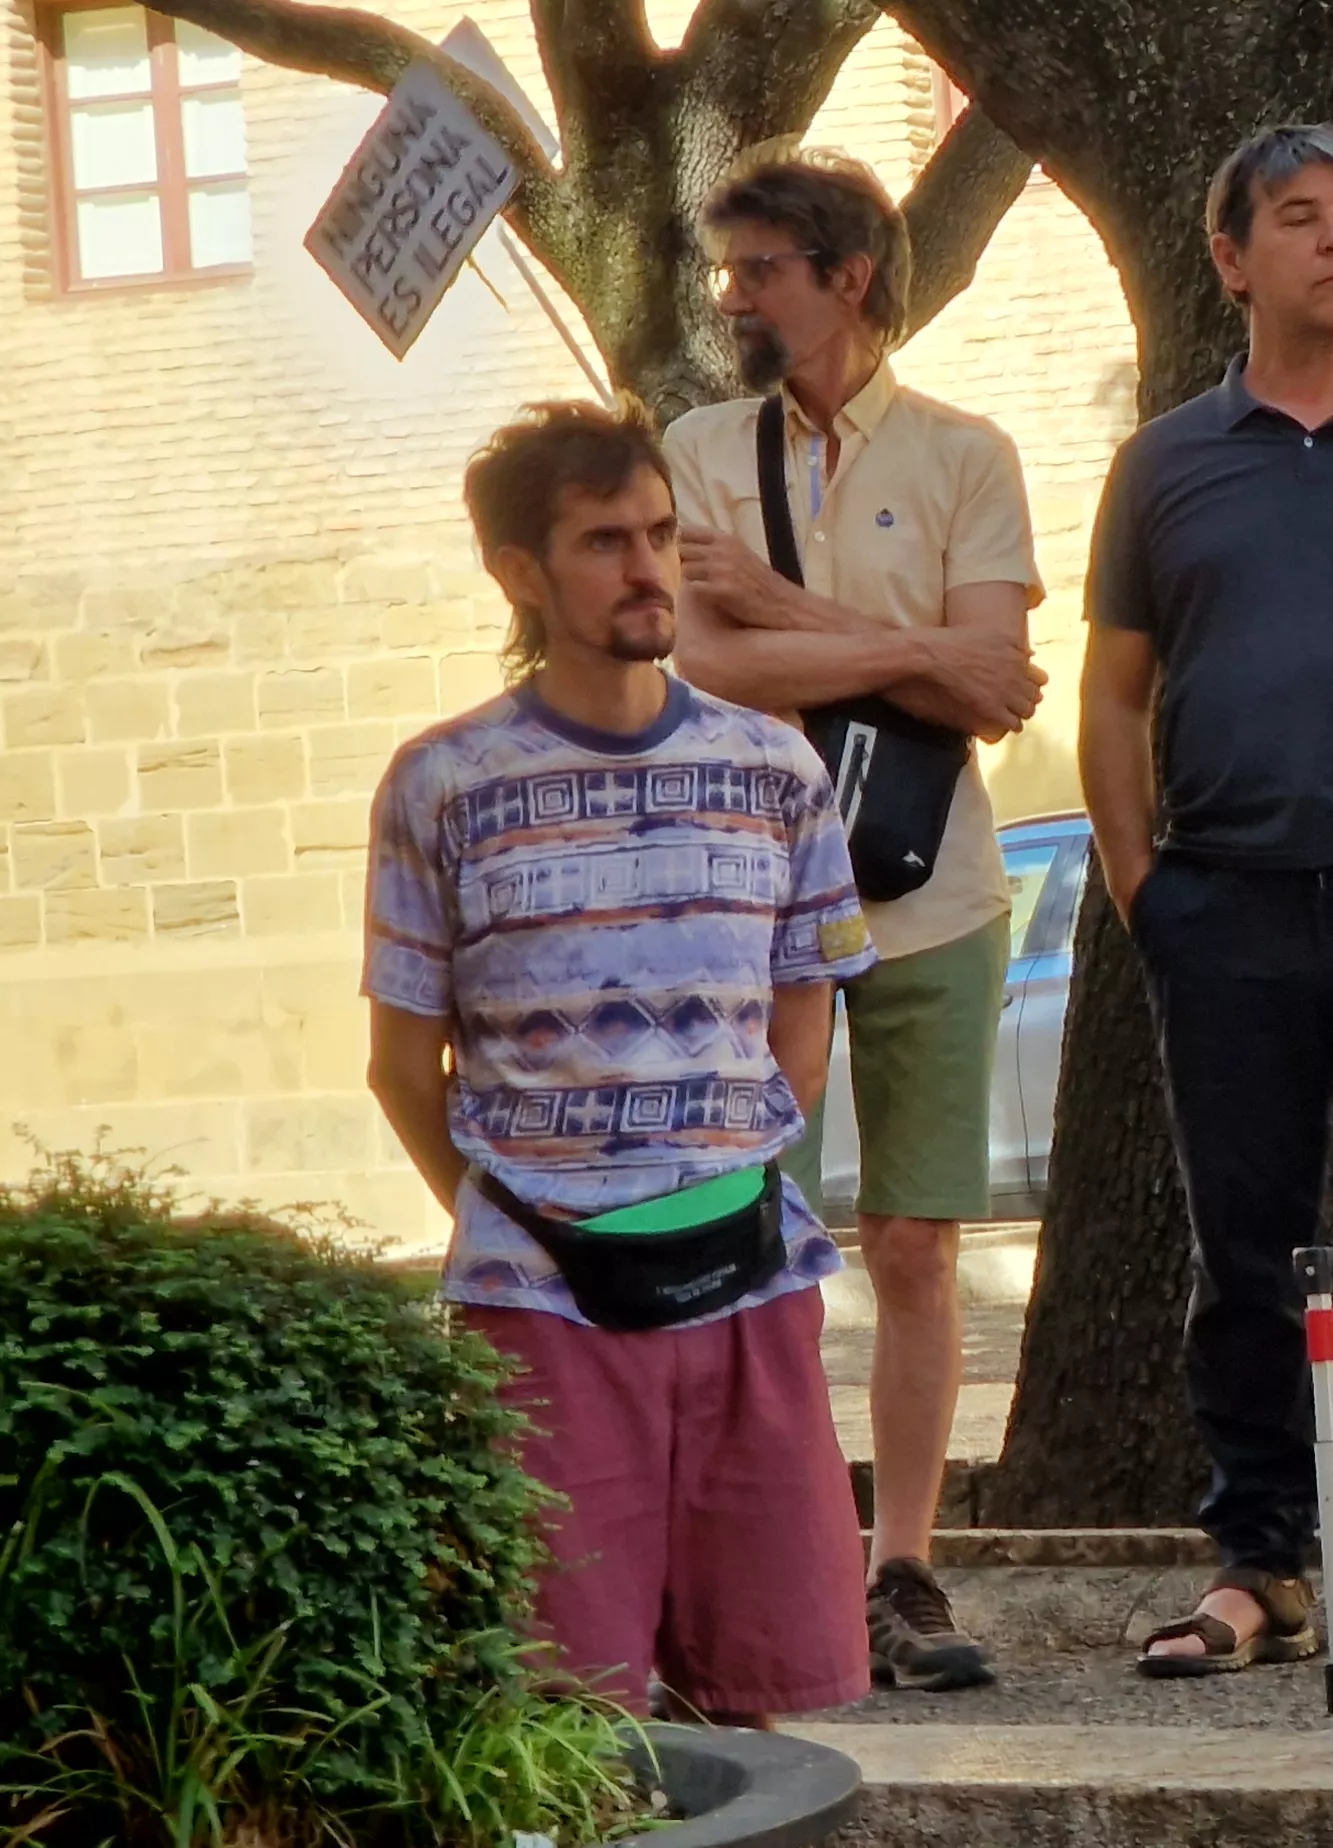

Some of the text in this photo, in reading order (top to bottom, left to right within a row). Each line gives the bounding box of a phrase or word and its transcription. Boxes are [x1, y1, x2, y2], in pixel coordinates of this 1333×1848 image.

[351, 125, 472, 296] PERSONA
[376, 154, 510, 338] ES ILEGAL
